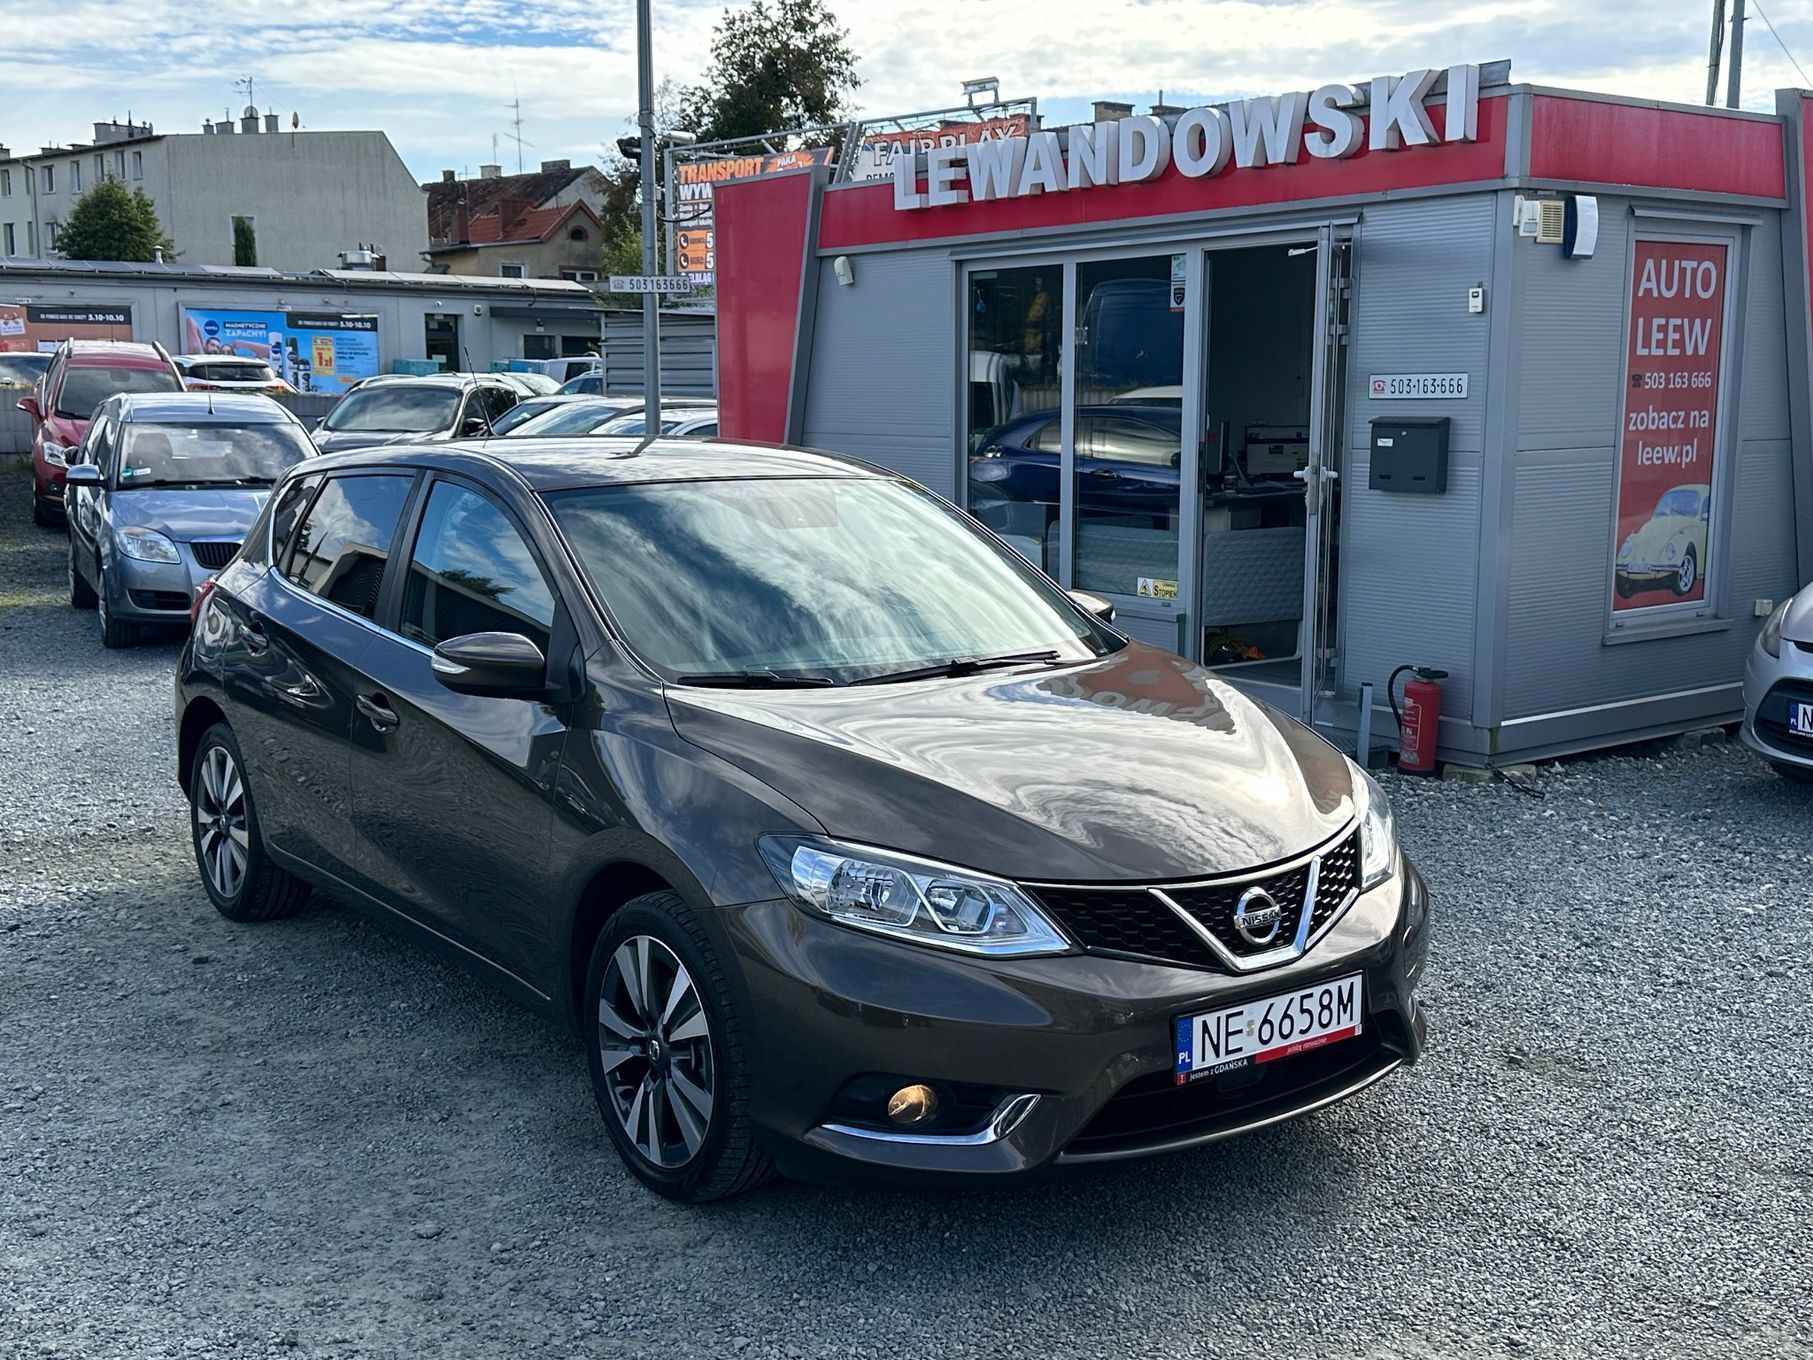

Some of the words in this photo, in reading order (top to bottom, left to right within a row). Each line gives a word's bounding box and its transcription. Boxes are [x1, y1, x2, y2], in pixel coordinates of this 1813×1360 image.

[894, 63, 1480, 211] LEWANDOWSKI
[678, 156, 764, 185] TRANSPORT
[679, 182, 713, 201] WYW
[1637, 258, 1717, 300] AUTO
[88, 313, 124, 322] 5.10-10.10
[1636, 317, 1712, 356] LEEW
[1644, 372, 1665, 389] 503
[1668, 372, 1688, 389] 163
[1691, 371, 1712, 388] 666
[1628, 405, 1685, 431] zobacz
[1689, 409, 1709, 428] na
[1637, 438, 1698, 469] leew.pl
[1201, 1009, 1244, 1063] NE
[1258, 981, 1355, 1046] 6658M
[1178, 1052, 1191, 1065] PL
